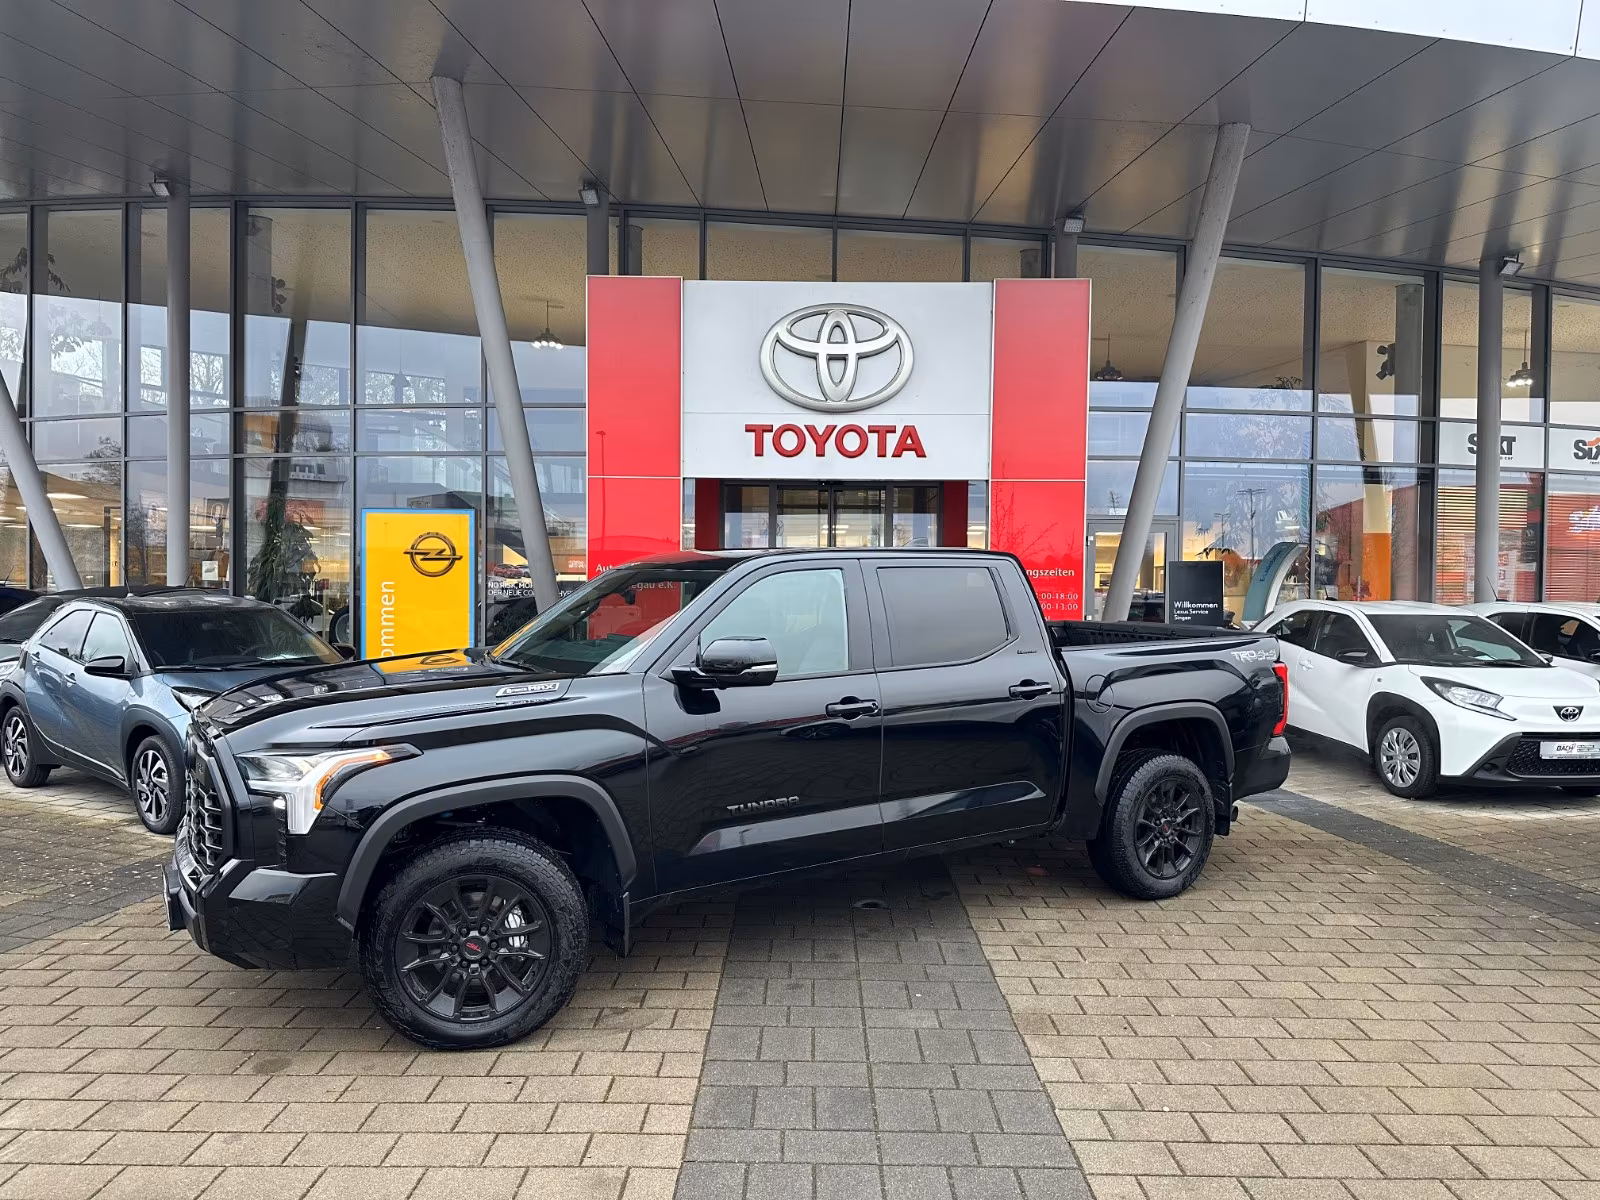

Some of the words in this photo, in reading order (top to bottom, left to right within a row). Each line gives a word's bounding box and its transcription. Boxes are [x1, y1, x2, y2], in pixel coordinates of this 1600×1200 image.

[745, 424, 927, 458] TOYOTA
[1026, 568, 1075, 579] ngszeiten
[629, 581, 655, 591] egau
[1036, 592, 1079, 600] :00-18:00
[1041, 603, 1079, 611] 00-13:00
[380, 581, 395, 657] ommen
[726, 796, 800, 816] TUNDRA
